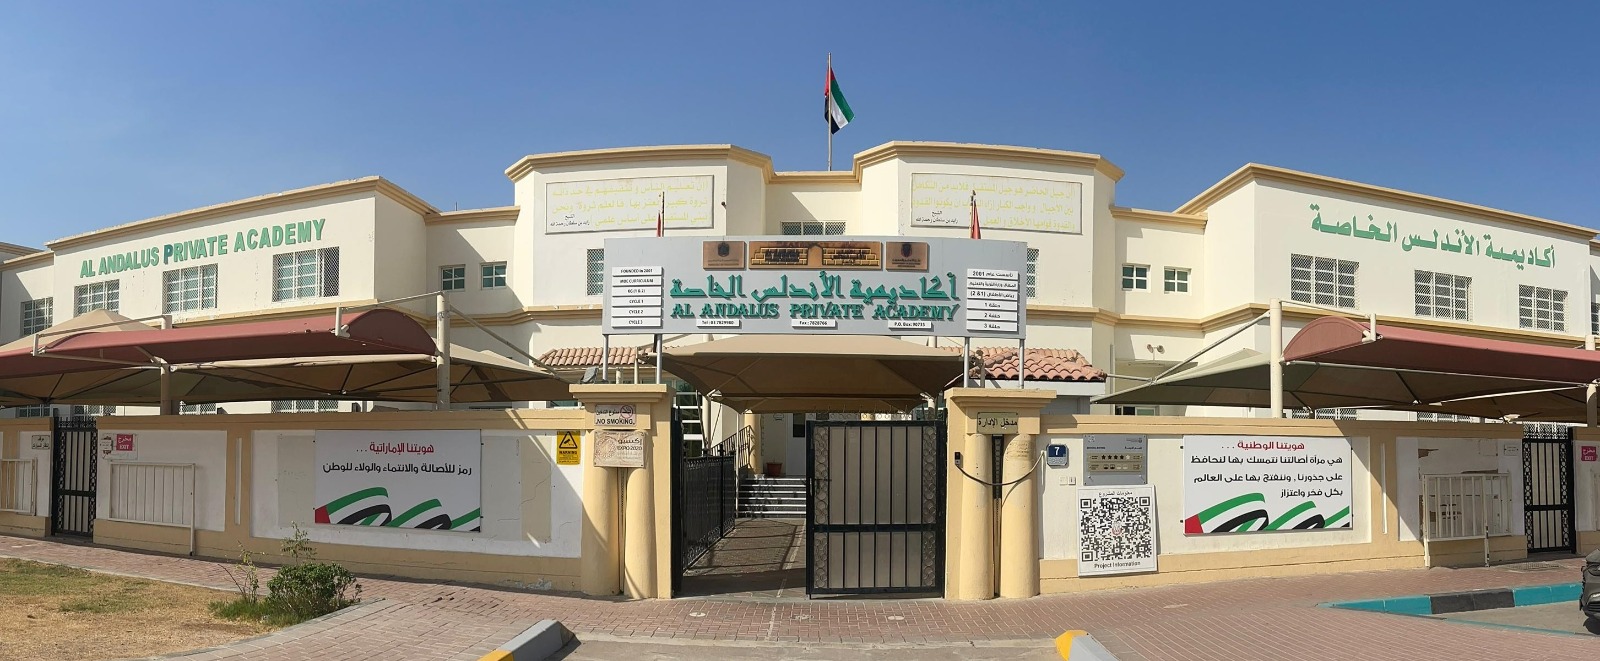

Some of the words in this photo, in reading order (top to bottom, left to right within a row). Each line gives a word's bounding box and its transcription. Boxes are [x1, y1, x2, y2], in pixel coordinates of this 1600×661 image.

[1309, 203, 1398, 243] الخاصة
[1401, 228, 1480, 256] الأندلس
[80, 259, 95, 278] AL
[98, 246, 159, 274] ANDALUS
[163, 234, 228, 264] PRIVATE
[233, 218, 326, 252] ACADEMY
[1483, 233, 1556, 271] أكاديمية
[670, 274, 747, 300] الخاصة
[751, 270, 844, 302] الأندلس
[850, 271, 960, 304] أكاديمية
[670, 303, 695, 319] AL
[700, 303, 781, 319] ANDALUS
[790, 302, 864, 320] PRIVATE
[872, 303, 961, 321] ACADEMY
[978, 418, 998, 428] الإدارة
[1000, 418, 1018, 428] مدخل
[117, 436, 132, 444] مخرج
[1237, 440, 1274, 450] الوطنية
[369, 441, 405, 455] الإماراتية
[406, 442, 435, 455] هويتنا
[1054, 446, 1060, 456] 7
[1276, 441, 1305, 452] هويتنا
[1191, 455, 1226, 464] لنحافظ
[1228, 456, 1243, 465] بها
[1246, 456, 1278, 464] نتمسك
[1280, 454, 1308, 464] أصالتنا
[1328, 458, 1343, 466] هي
[322, 462, 353, 473] للوطن
[354, 463, 381, 473] والولاء
[382, 463, 419, 474] والانتماء
[421, 463, 455, 474] للأصالة
[457, 465, 472, 476] رمز
[1193, 474, 1223, 483] العالم
[1224, 474, 1243, 483] على
[1245, 474, 1261, 482] بها
[1262, 473, 1292, 483] وننفتح
[1326, 473, 1343, 482] على
[1280, 489, 1306, 498] واعتزاز
[1307, 489, 1322, 498] فخر
[1324, 488, 1343, 497] بكل
